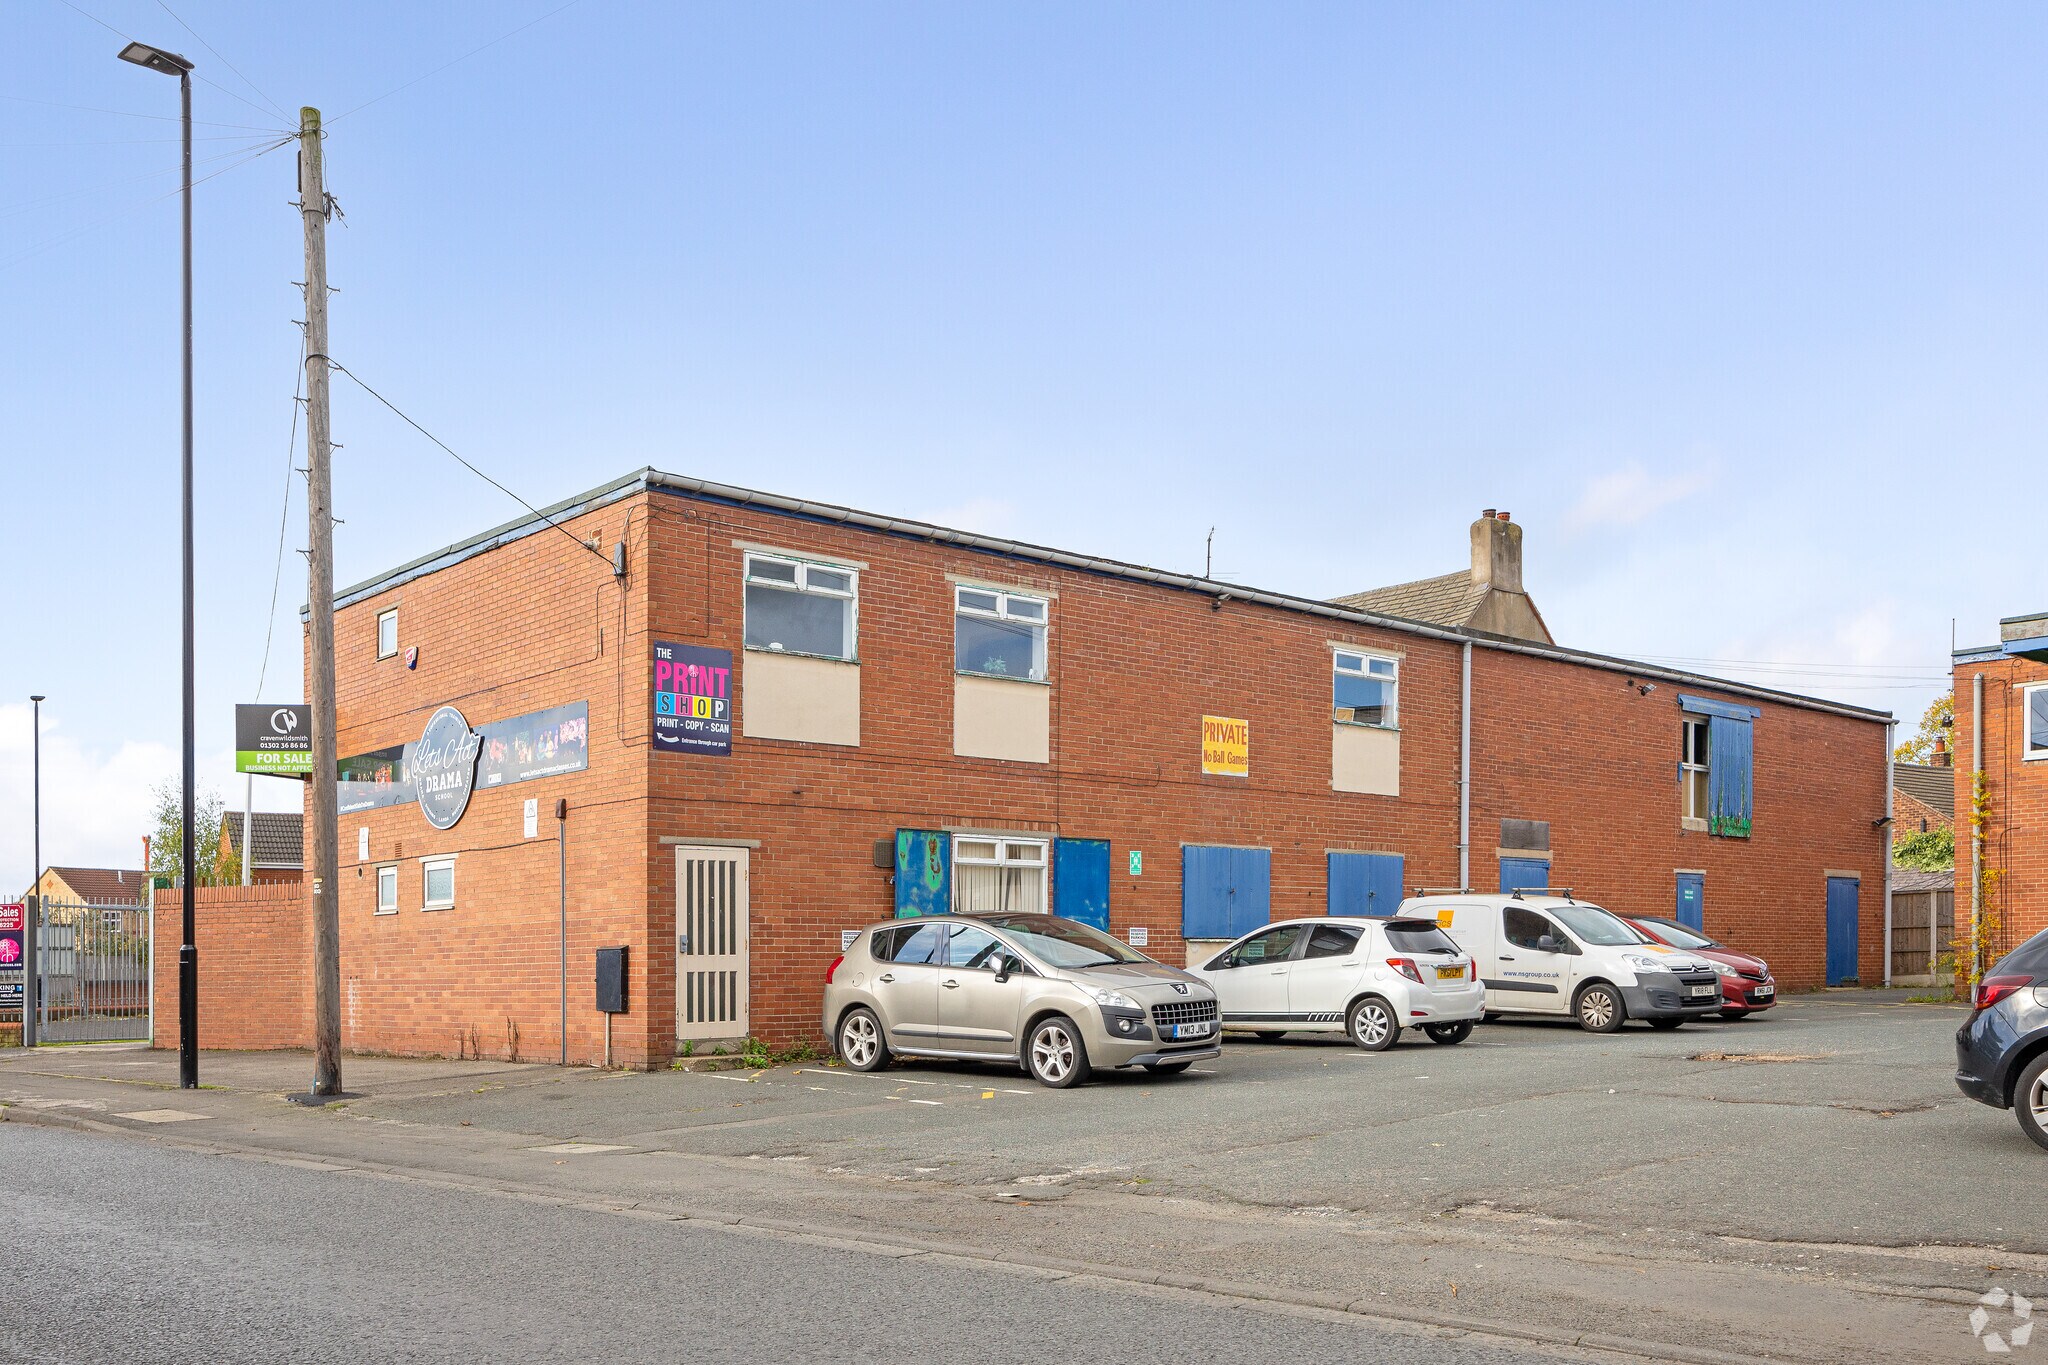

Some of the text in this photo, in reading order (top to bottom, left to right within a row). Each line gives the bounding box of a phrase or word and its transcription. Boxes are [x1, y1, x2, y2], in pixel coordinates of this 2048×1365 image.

[656, 647, 672, 659] THE
[661, 695, 724, 718] SHOP
[657, 717, 679, 728] PRINT
[685, 720, 704, 731] COPY
[711, 723, 729, 734] SCAN
[1204, 721, 1247, 745] PRIVATE
[698, 739, 711, 747] through
[256, 753, 312, 764] FOR SALE
[1203, 749, 1248, 766] No Ball Games
[426, 770, 462, 794] DRAMA
[434, 792, 453, 801] SCHOOL
[0, 907, 19, 917] Sales
[1503, 971, 1560, 979] www.nsgroup.co.uk
[1180, 1023, 1208, 1036] YM13 JNL
